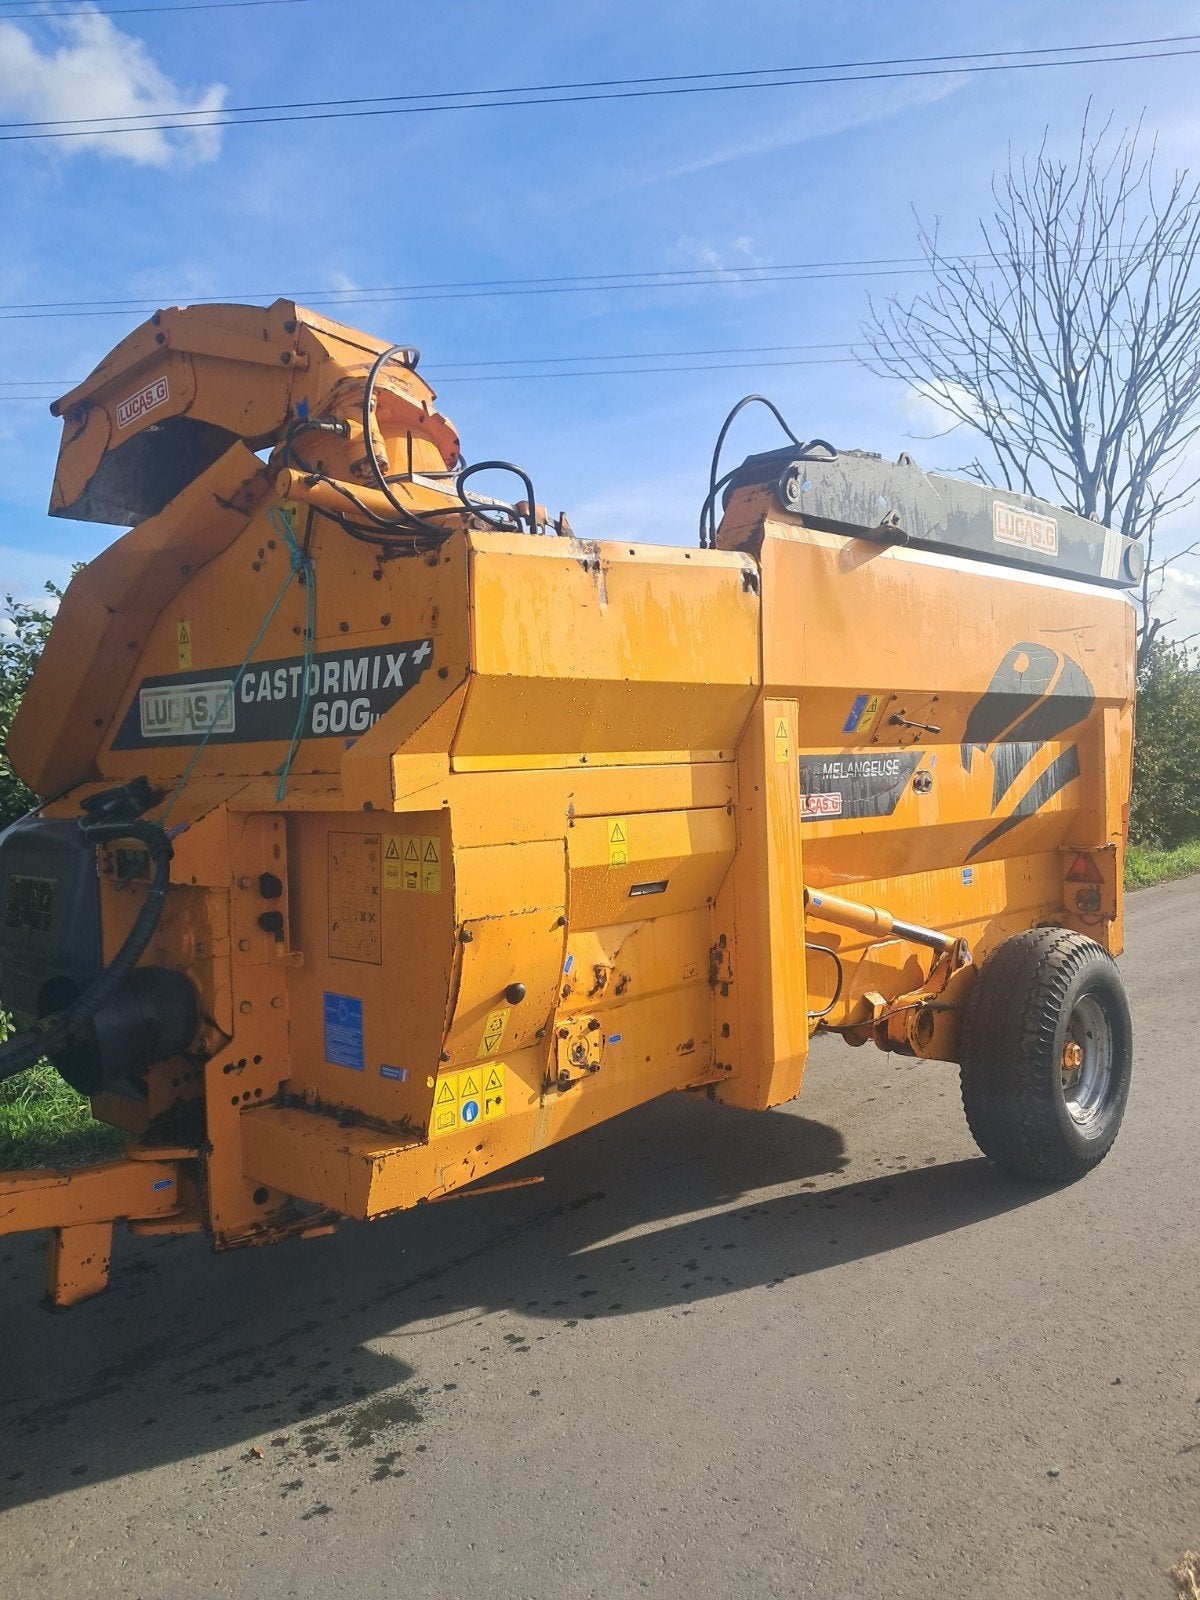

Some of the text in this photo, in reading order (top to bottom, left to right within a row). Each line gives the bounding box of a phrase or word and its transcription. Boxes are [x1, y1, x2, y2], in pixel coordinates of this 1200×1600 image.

[119, 383, 165, 423] LUCAS.G
[997, 509, 1055, 547] LUCAS.G
[145, 693, 230, 730] LUCAS.G
[822, 759, 900, 780] MELANGEUSE
